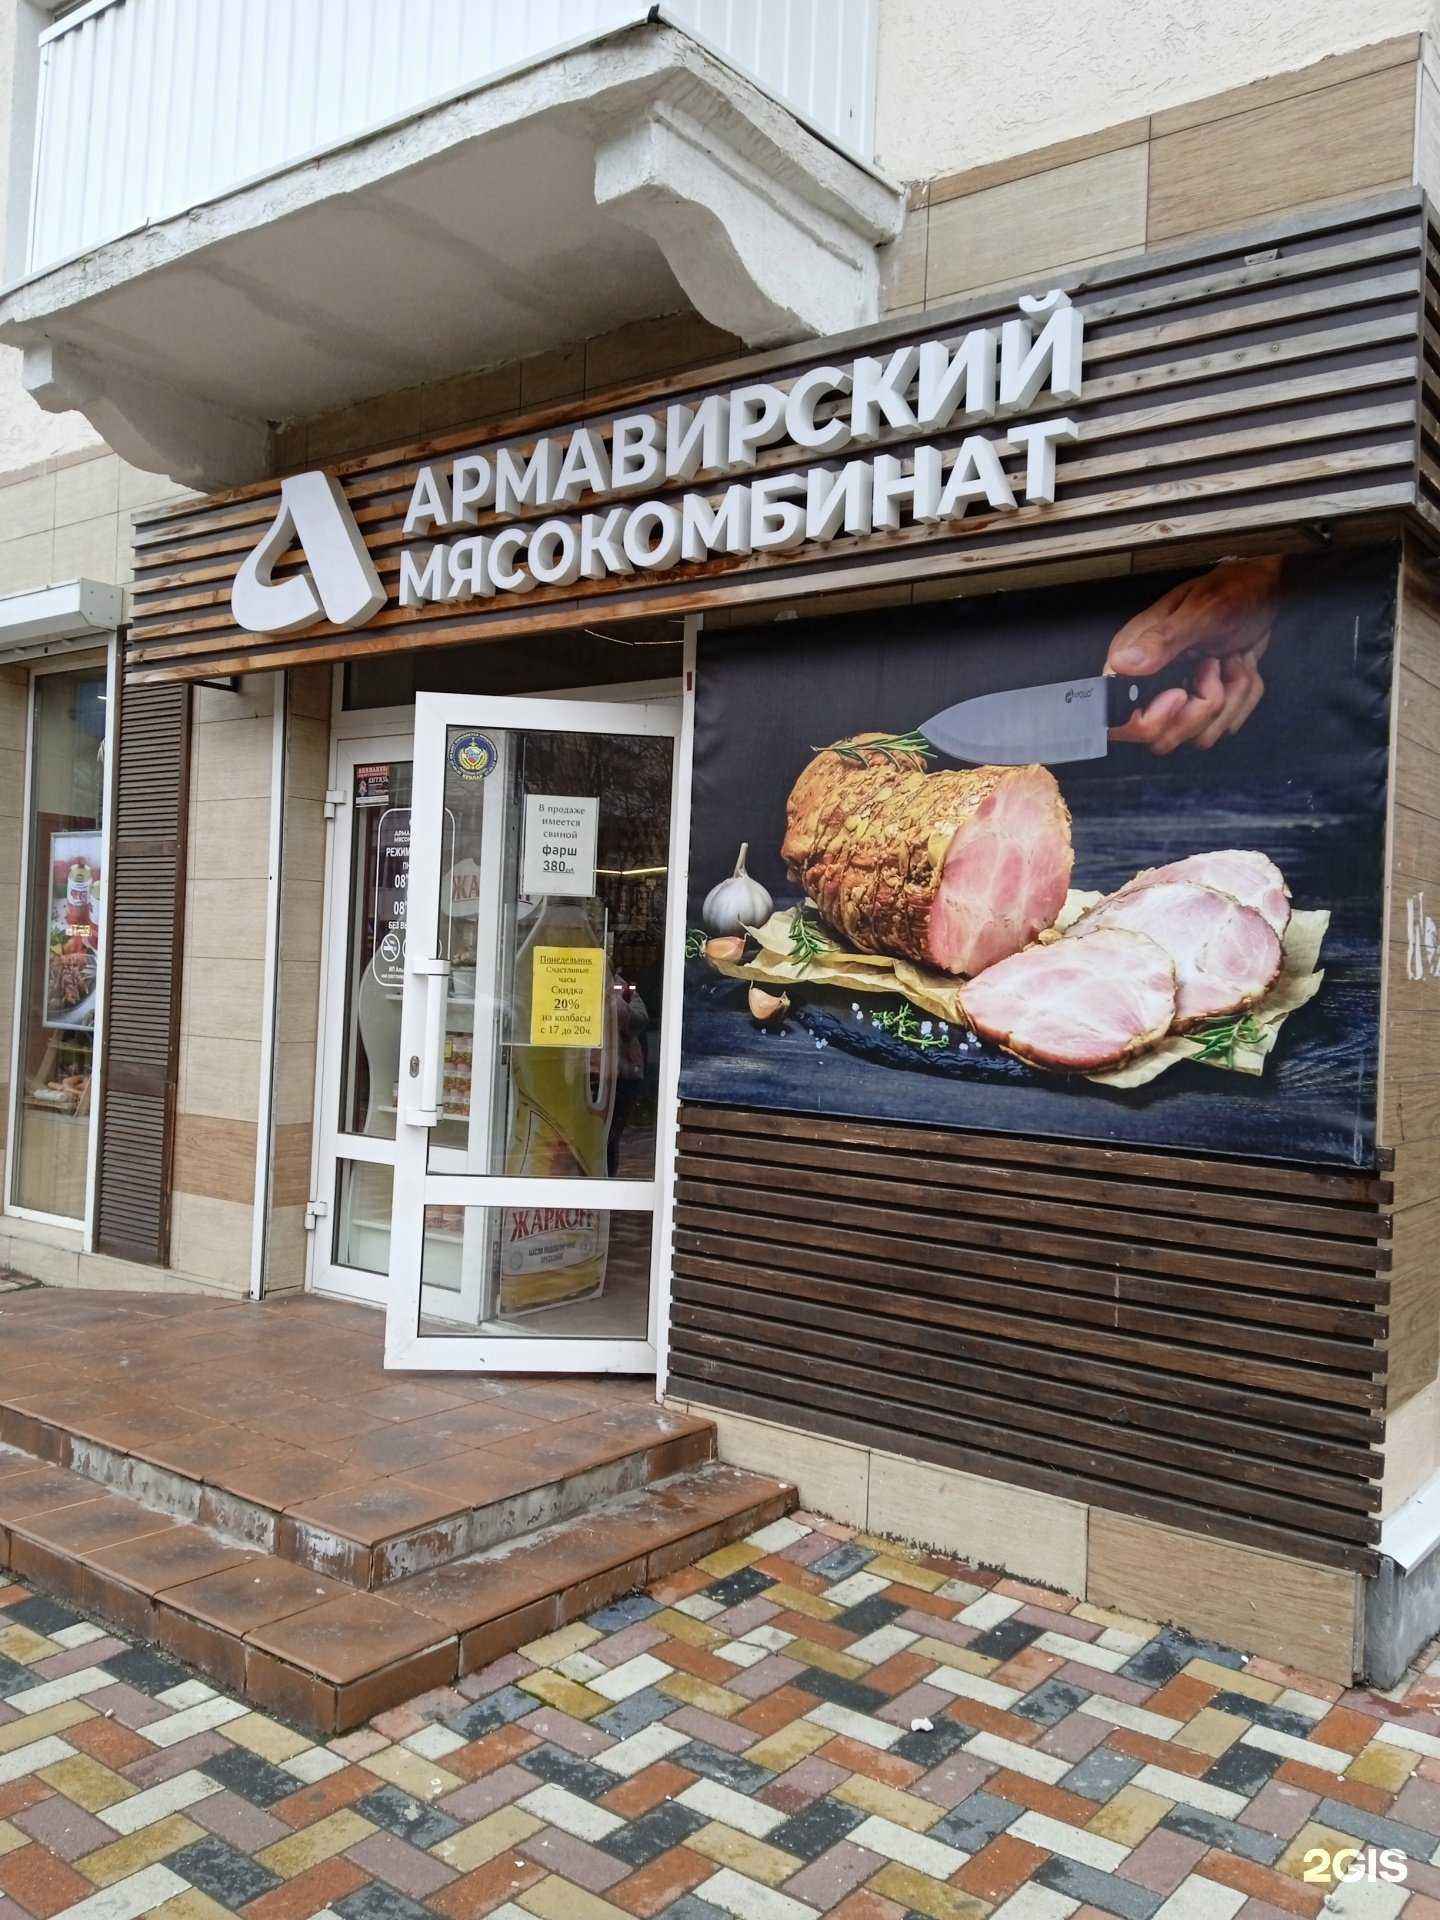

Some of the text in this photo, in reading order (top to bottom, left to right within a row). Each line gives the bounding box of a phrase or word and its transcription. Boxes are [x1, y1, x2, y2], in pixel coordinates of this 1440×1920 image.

[402, 289, 1083, 537] АРМАВИРСКИЙ
[399, 417, 1079, 610] МЯСОКОМБИНАТ
[538, 803, 586, 816] В продаже
[541, 818, 581, 827] имеется
[543, 830, 578, 840] свиной
[542, 843, 577, 858] фарш
[551, 985, 584, 996] Скидка
[553, 998, 580, 1010] 20%
[555, 1012, 592, 1023] колбасы
[549, 1025, 559, 1034] 17
[561, 1028, 572, 1036] до
